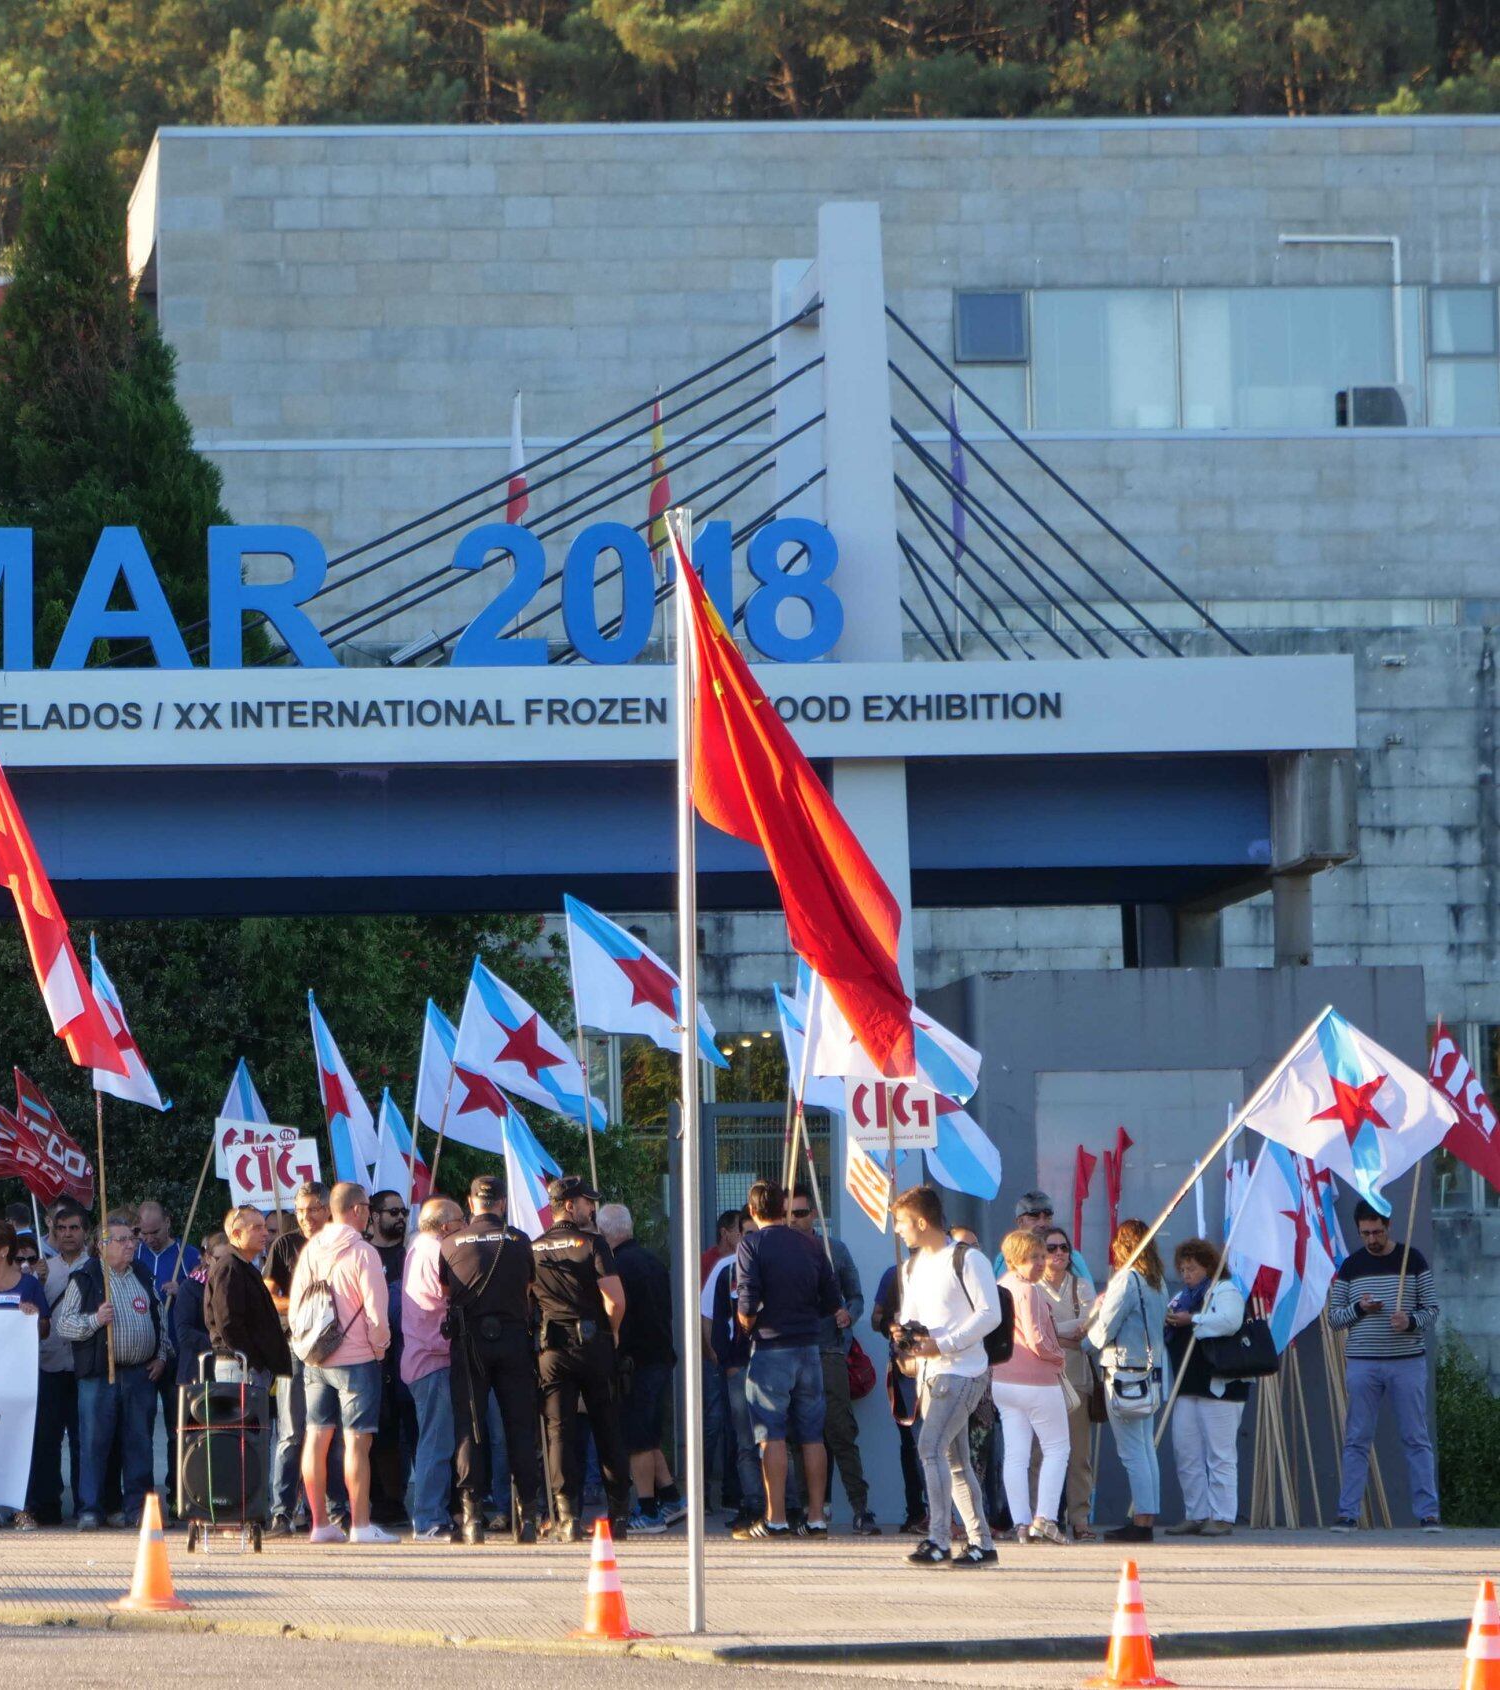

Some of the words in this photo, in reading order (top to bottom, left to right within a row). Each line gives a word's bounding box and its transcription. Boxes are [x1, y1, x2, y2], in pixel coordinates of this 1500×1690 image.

[450, 517, 844, 666] 2018
[174, 702, 224, 730] XX
[231, 699, 514, 730] INTERNATIONAL
[525, 697, 667, 726] FROZEN
[863, 691, 1062, 722] EXHIBITION
[852, 1082, 930, 1129] CIG
[1433, 1037, 1497, 1135] CIG
[235, 1148, 314, 1193] CIG
